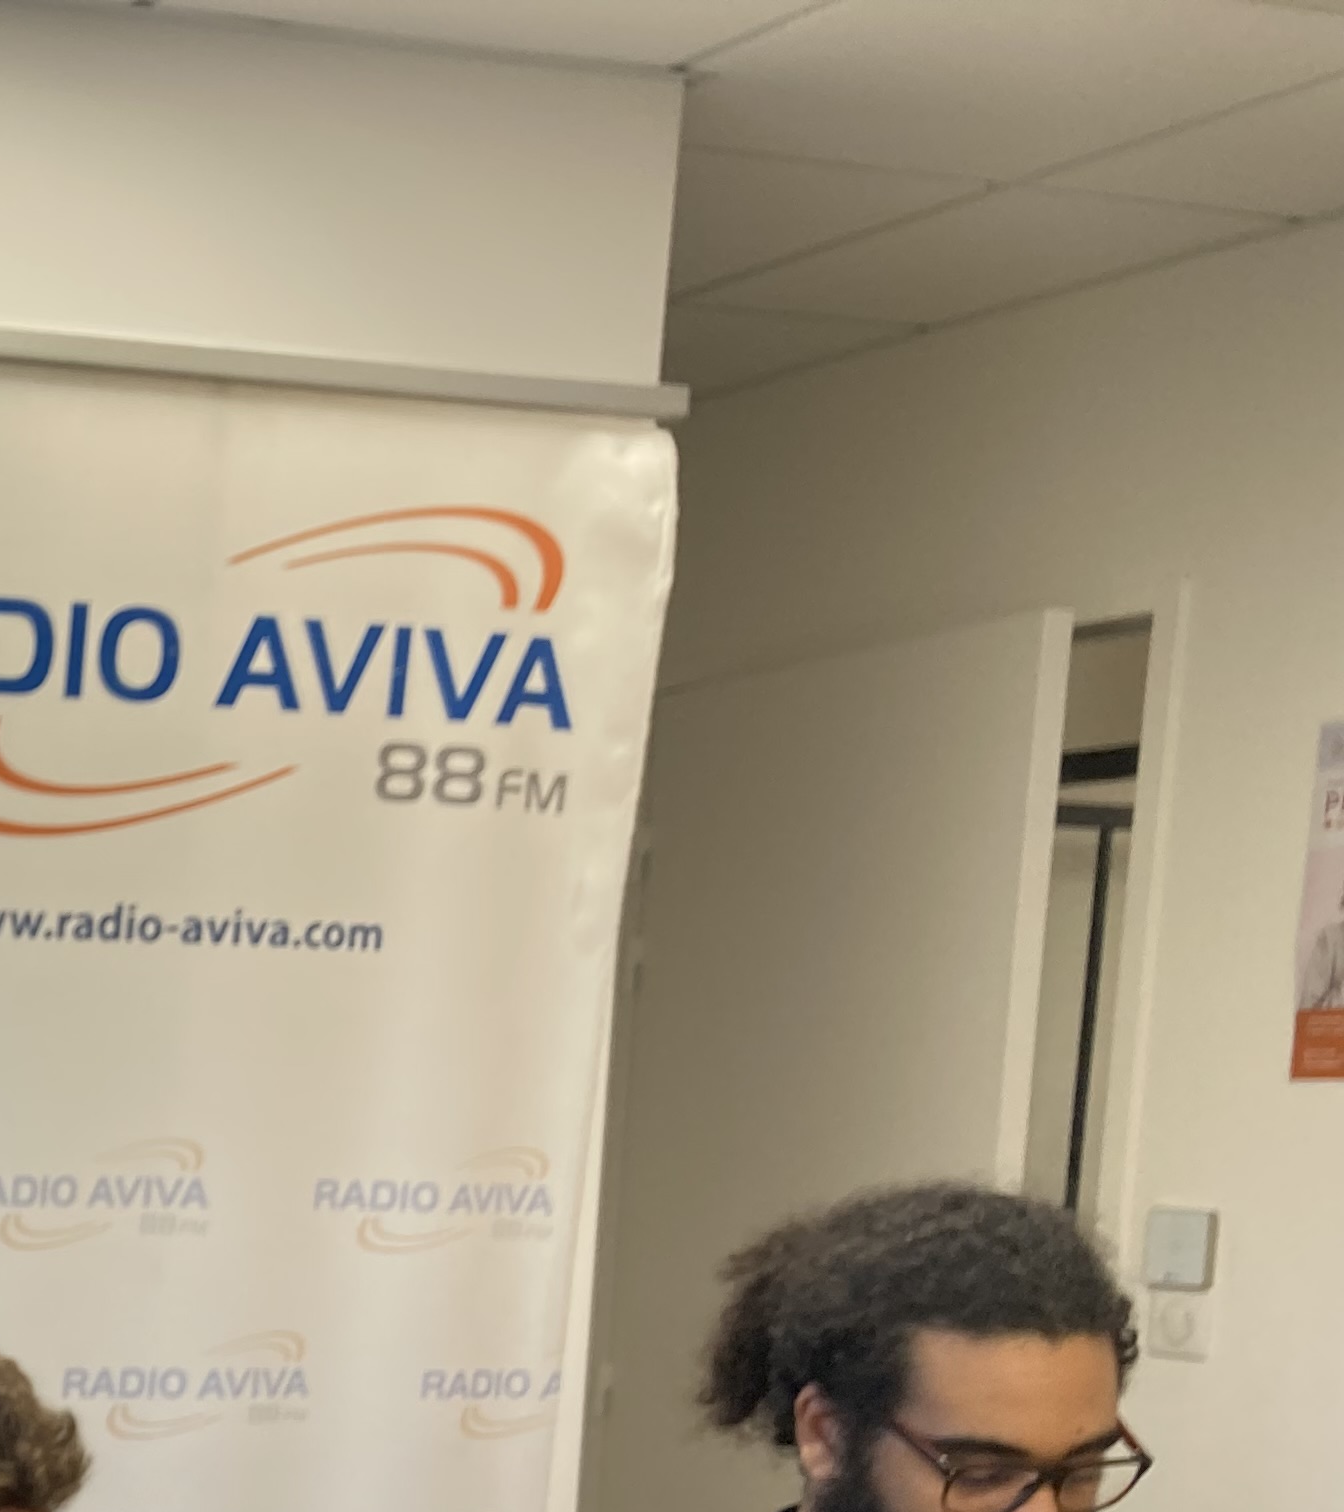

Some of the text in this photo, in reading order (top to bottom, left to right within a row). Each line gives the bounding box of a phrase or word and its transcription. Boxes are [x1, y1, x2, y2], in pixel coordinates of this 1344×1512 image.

[214, 615, 574, 731] AVIVA
[375, 741, 569, 815] 88 FM
[86, 1174, 209, 1210] AVIVA
[313, 1177, 553, 1216] RADIO AVIVA
[62, 1367, 309, 1400] RADIO AVIVA
[420, 1368, 531, 1401] RADIO
